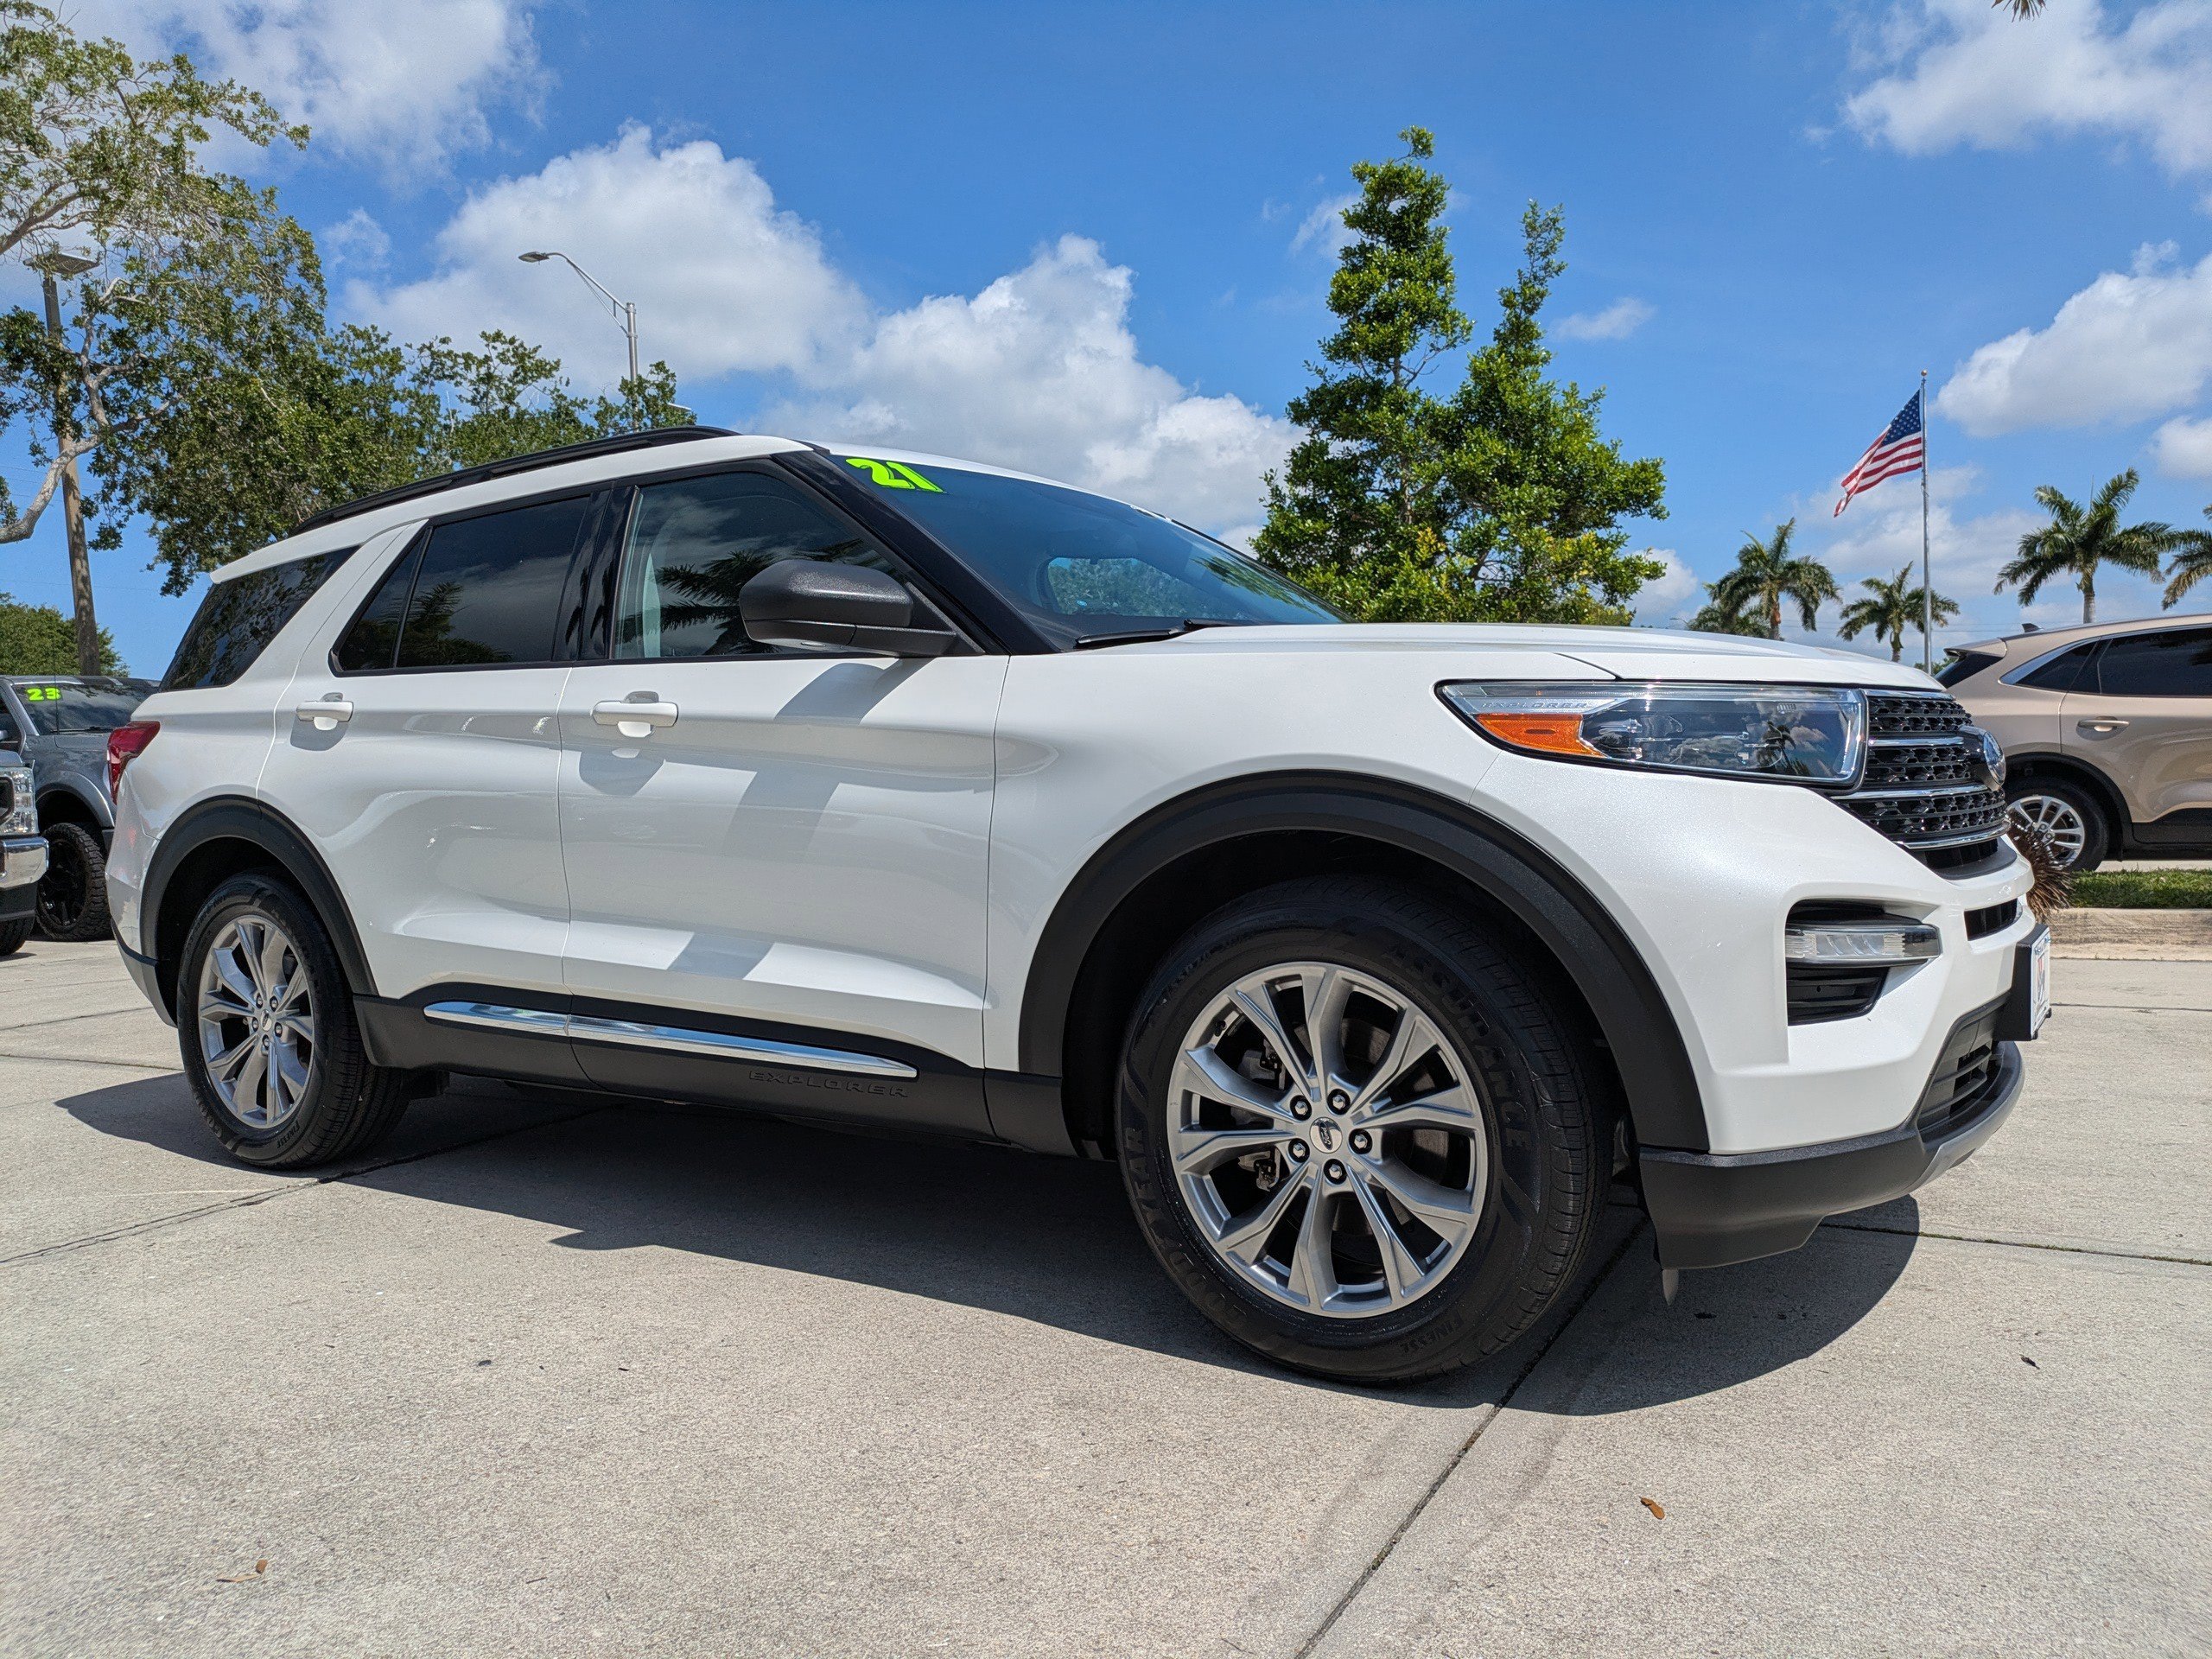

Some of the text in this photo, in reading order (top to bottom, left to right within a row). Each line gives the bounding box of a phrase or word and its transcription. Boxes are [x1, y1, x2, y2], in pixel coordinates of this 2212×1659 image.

[845, 458, 944, 493] 21
[25, 687, 61, 702] 23
[748, 1071, 908, 1097] EXPLORER
